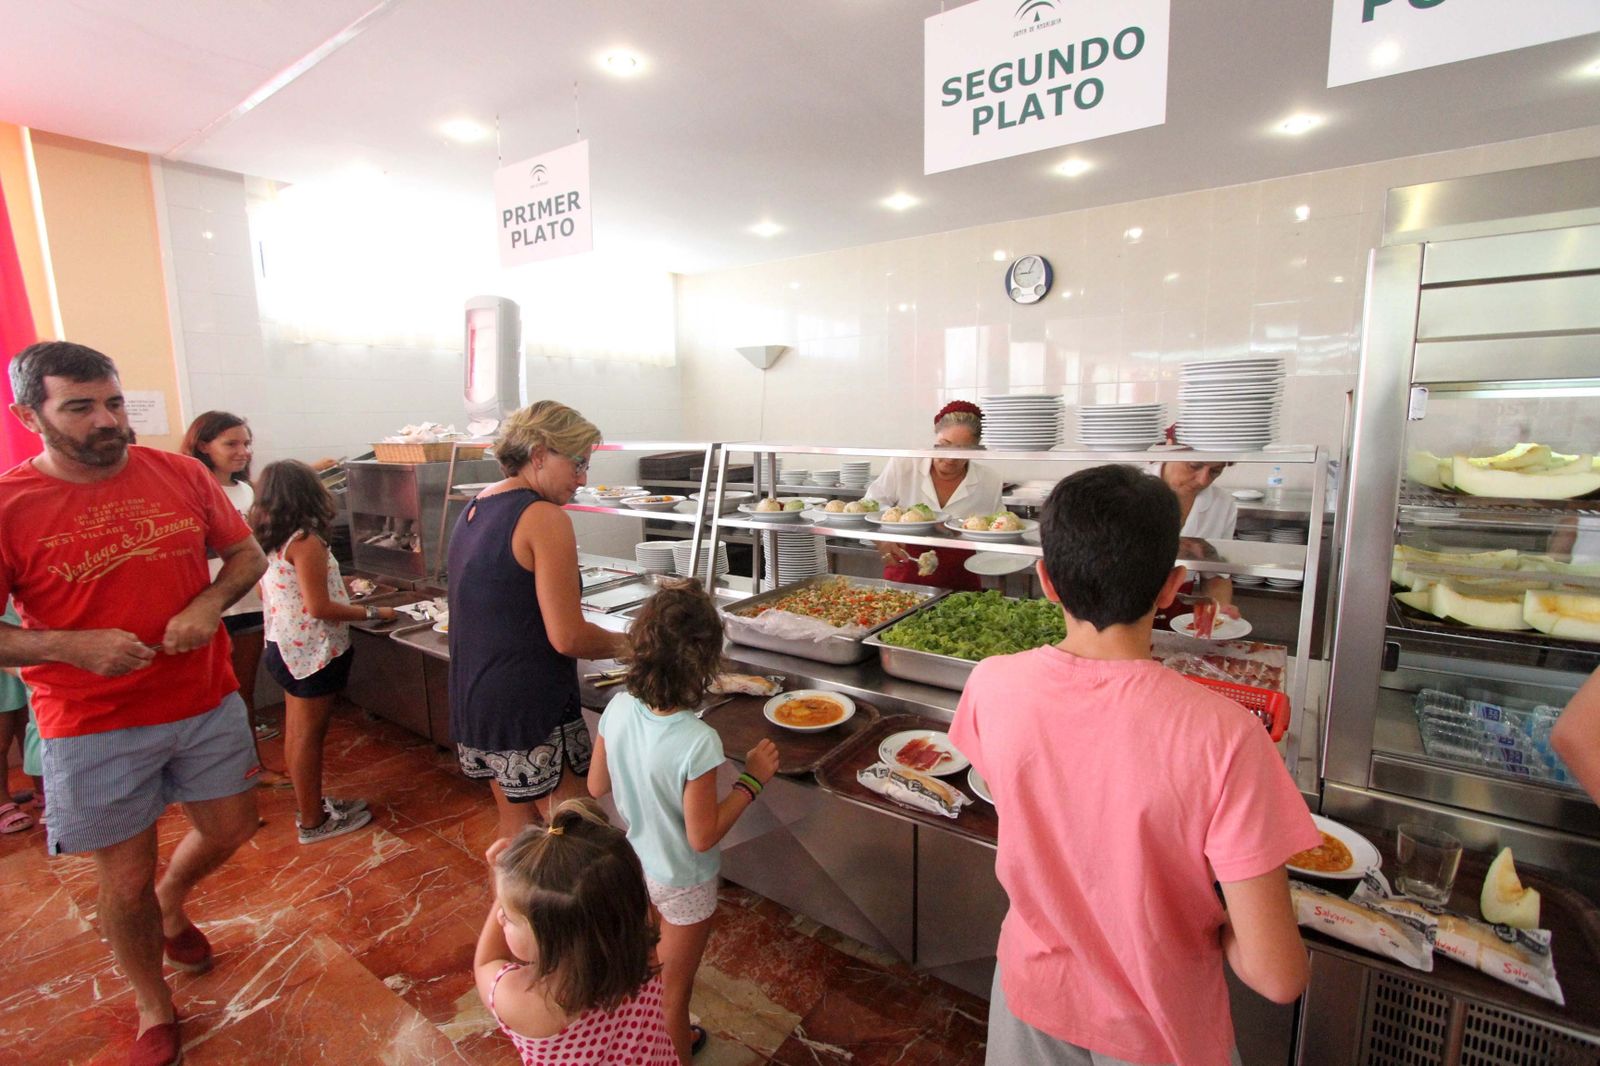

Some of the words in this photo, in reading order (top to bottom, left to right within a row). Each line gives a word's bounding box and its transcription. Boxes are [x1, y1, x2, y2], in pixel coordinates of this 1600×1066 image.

[941, 26, 1146, 107] SEGUNDO
[972, 77, 1104, 136] PLATO
[502, 190, 582, 228] PRIMER
[511, 217, 575, 249] PLATO
[44, 536, 74, 548] WEST
[81, 526, 126, 539] VILLAGE
[48, 543, 118, 582] Vintage
[122, 534, 136, 549] &
